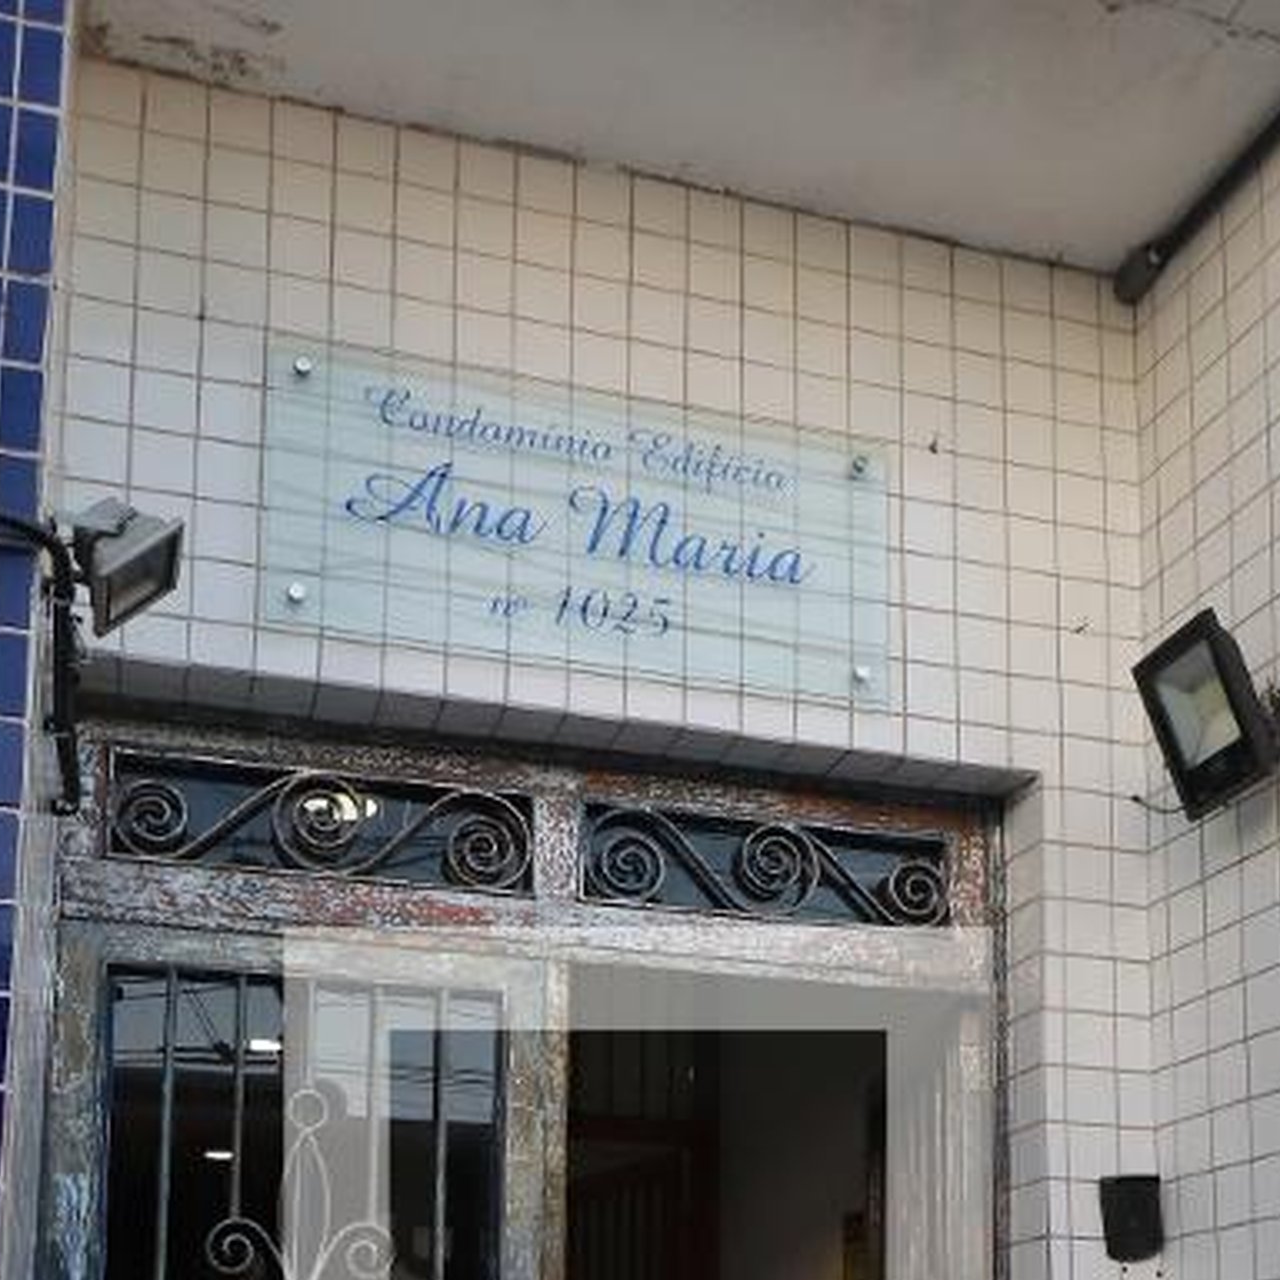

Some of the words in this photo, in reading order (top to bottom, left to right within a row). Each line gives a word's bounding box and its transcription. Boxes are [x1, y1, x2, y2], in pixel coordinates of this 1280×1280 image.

[345, 460, 548, 546] Ana
[568, 484, 814, 586] Maria
[555, 585, 670, 637] 1025
